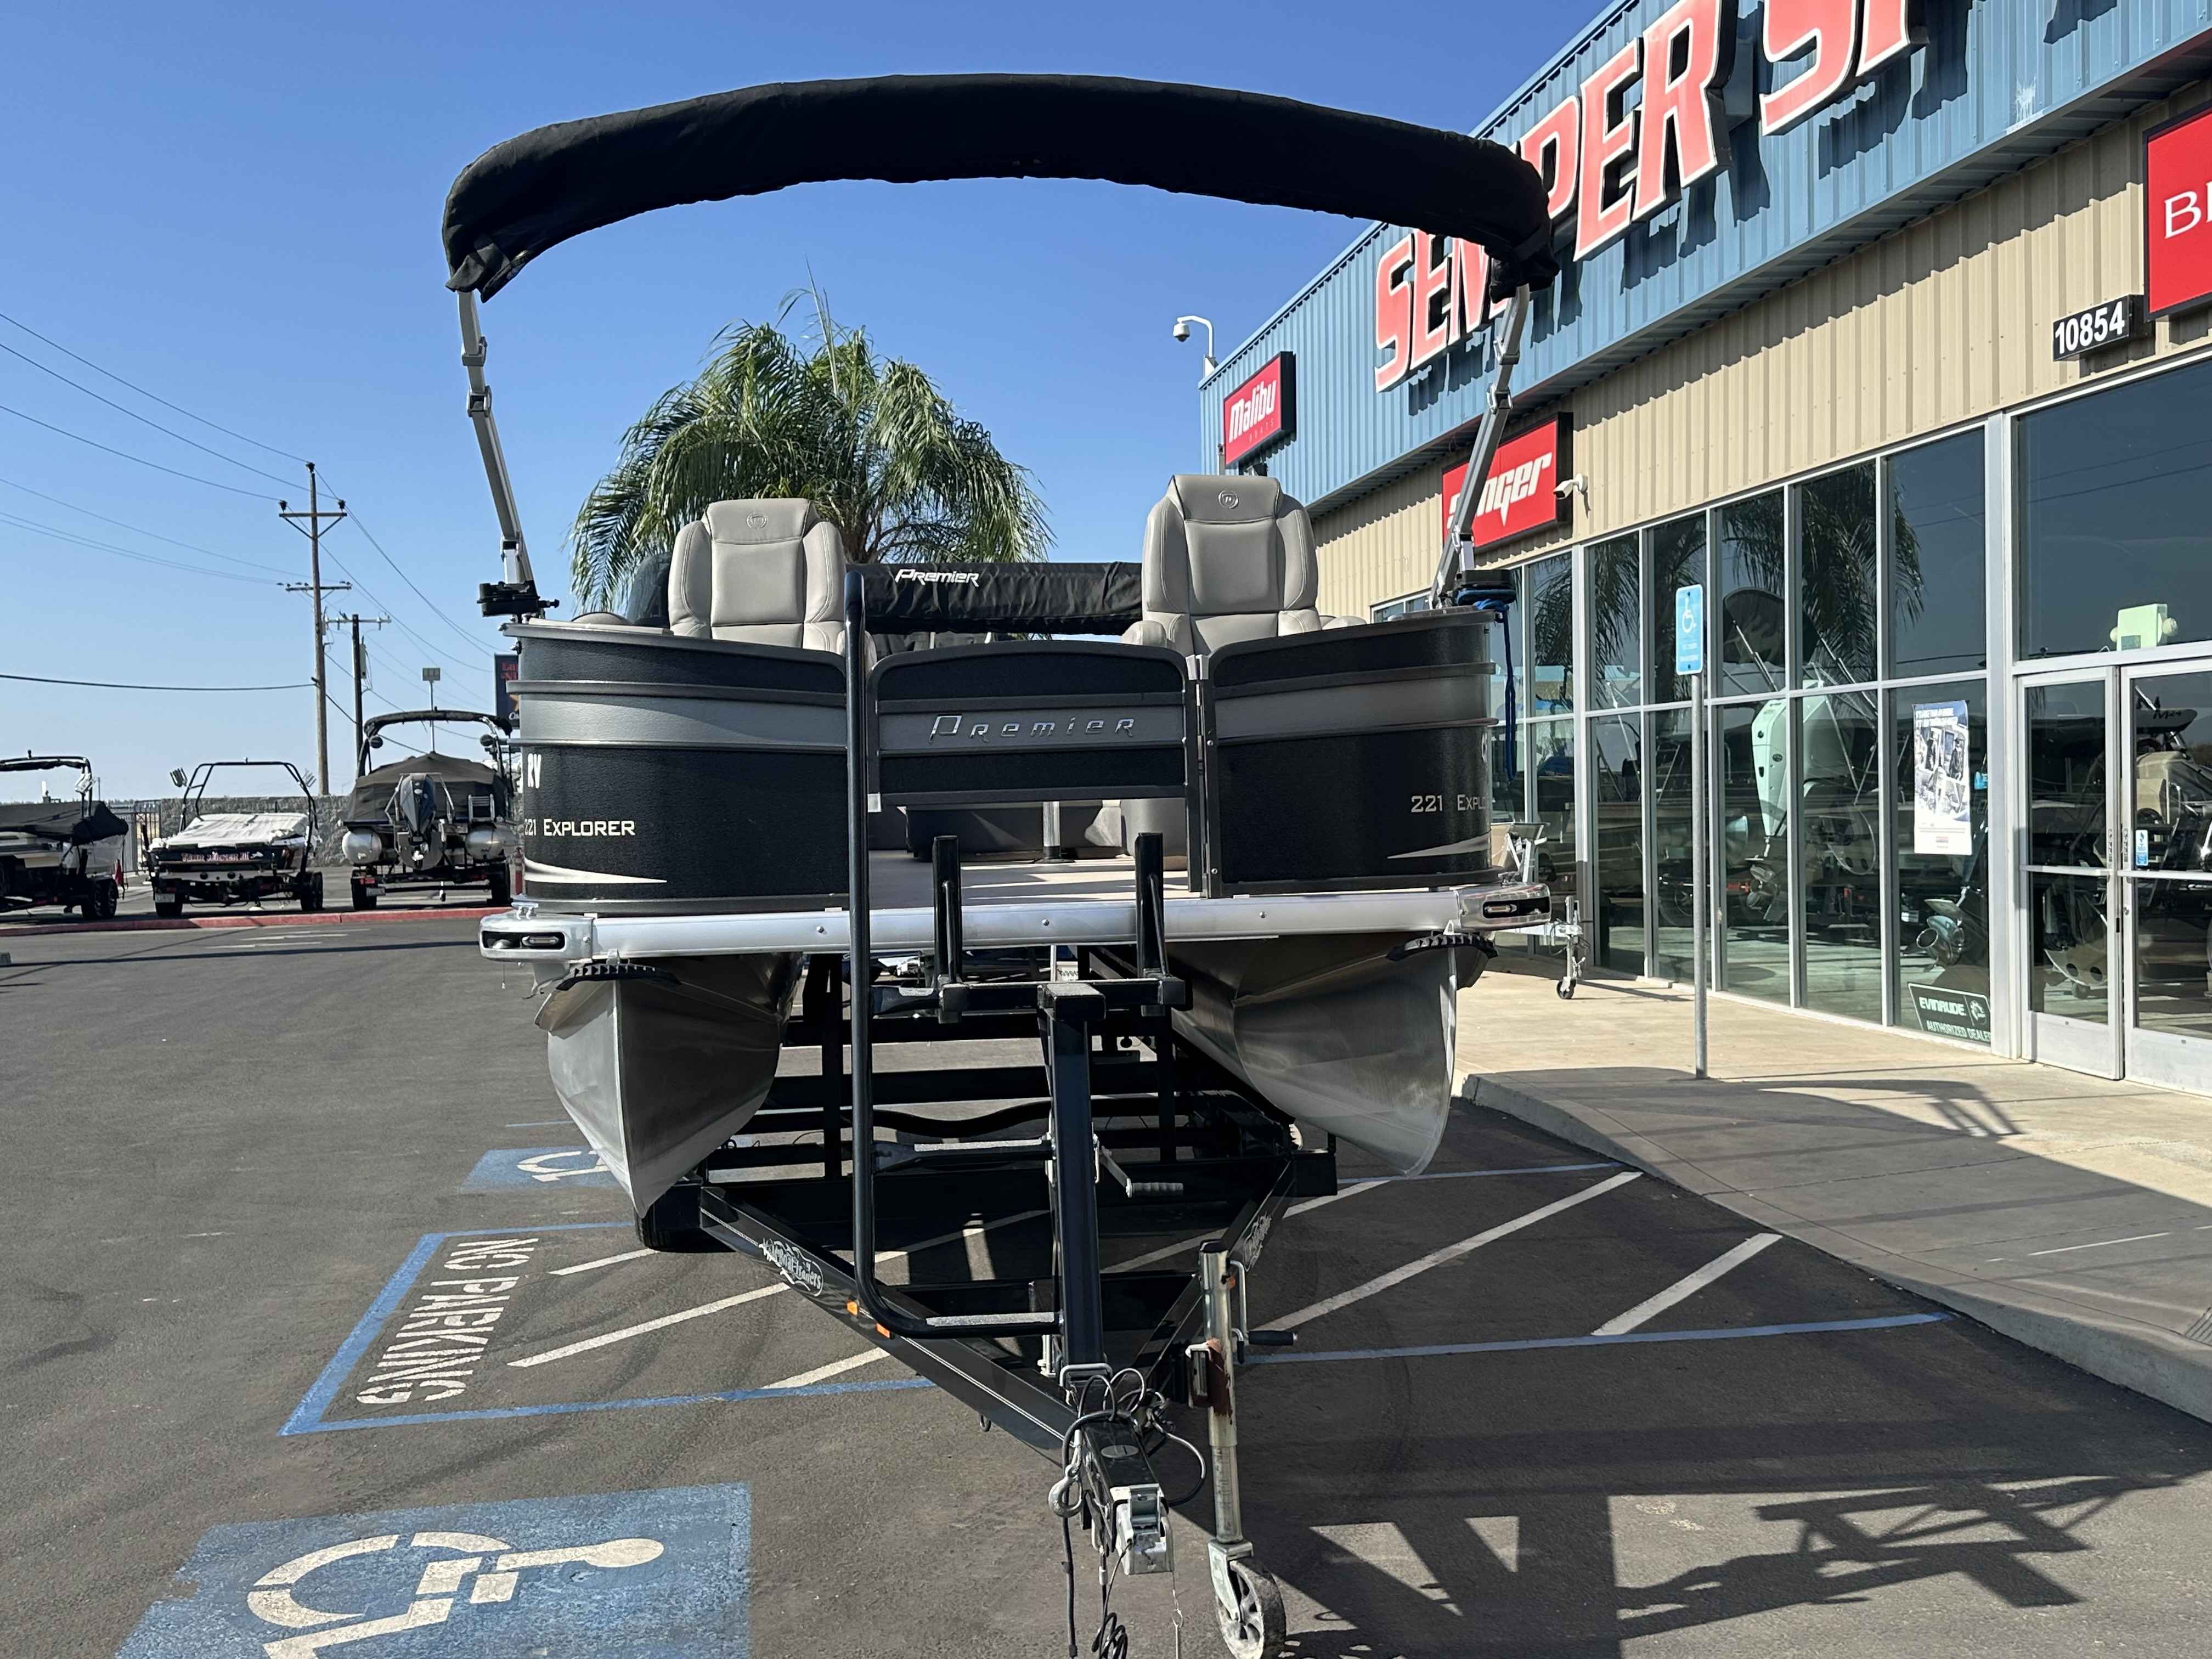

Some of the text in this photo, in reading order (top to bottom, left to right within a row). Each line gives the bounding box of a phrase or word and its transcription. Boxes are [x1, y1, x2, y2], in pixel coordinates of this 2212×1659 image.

[2164, 181, 2212, 239] B
[2055, 301, 2125, 354] 10854
[1447, 452, 1553, 529] nger
[1411, 794, 1443, 812] 221
[356, 1238, 539, 1404] NO PARKING
